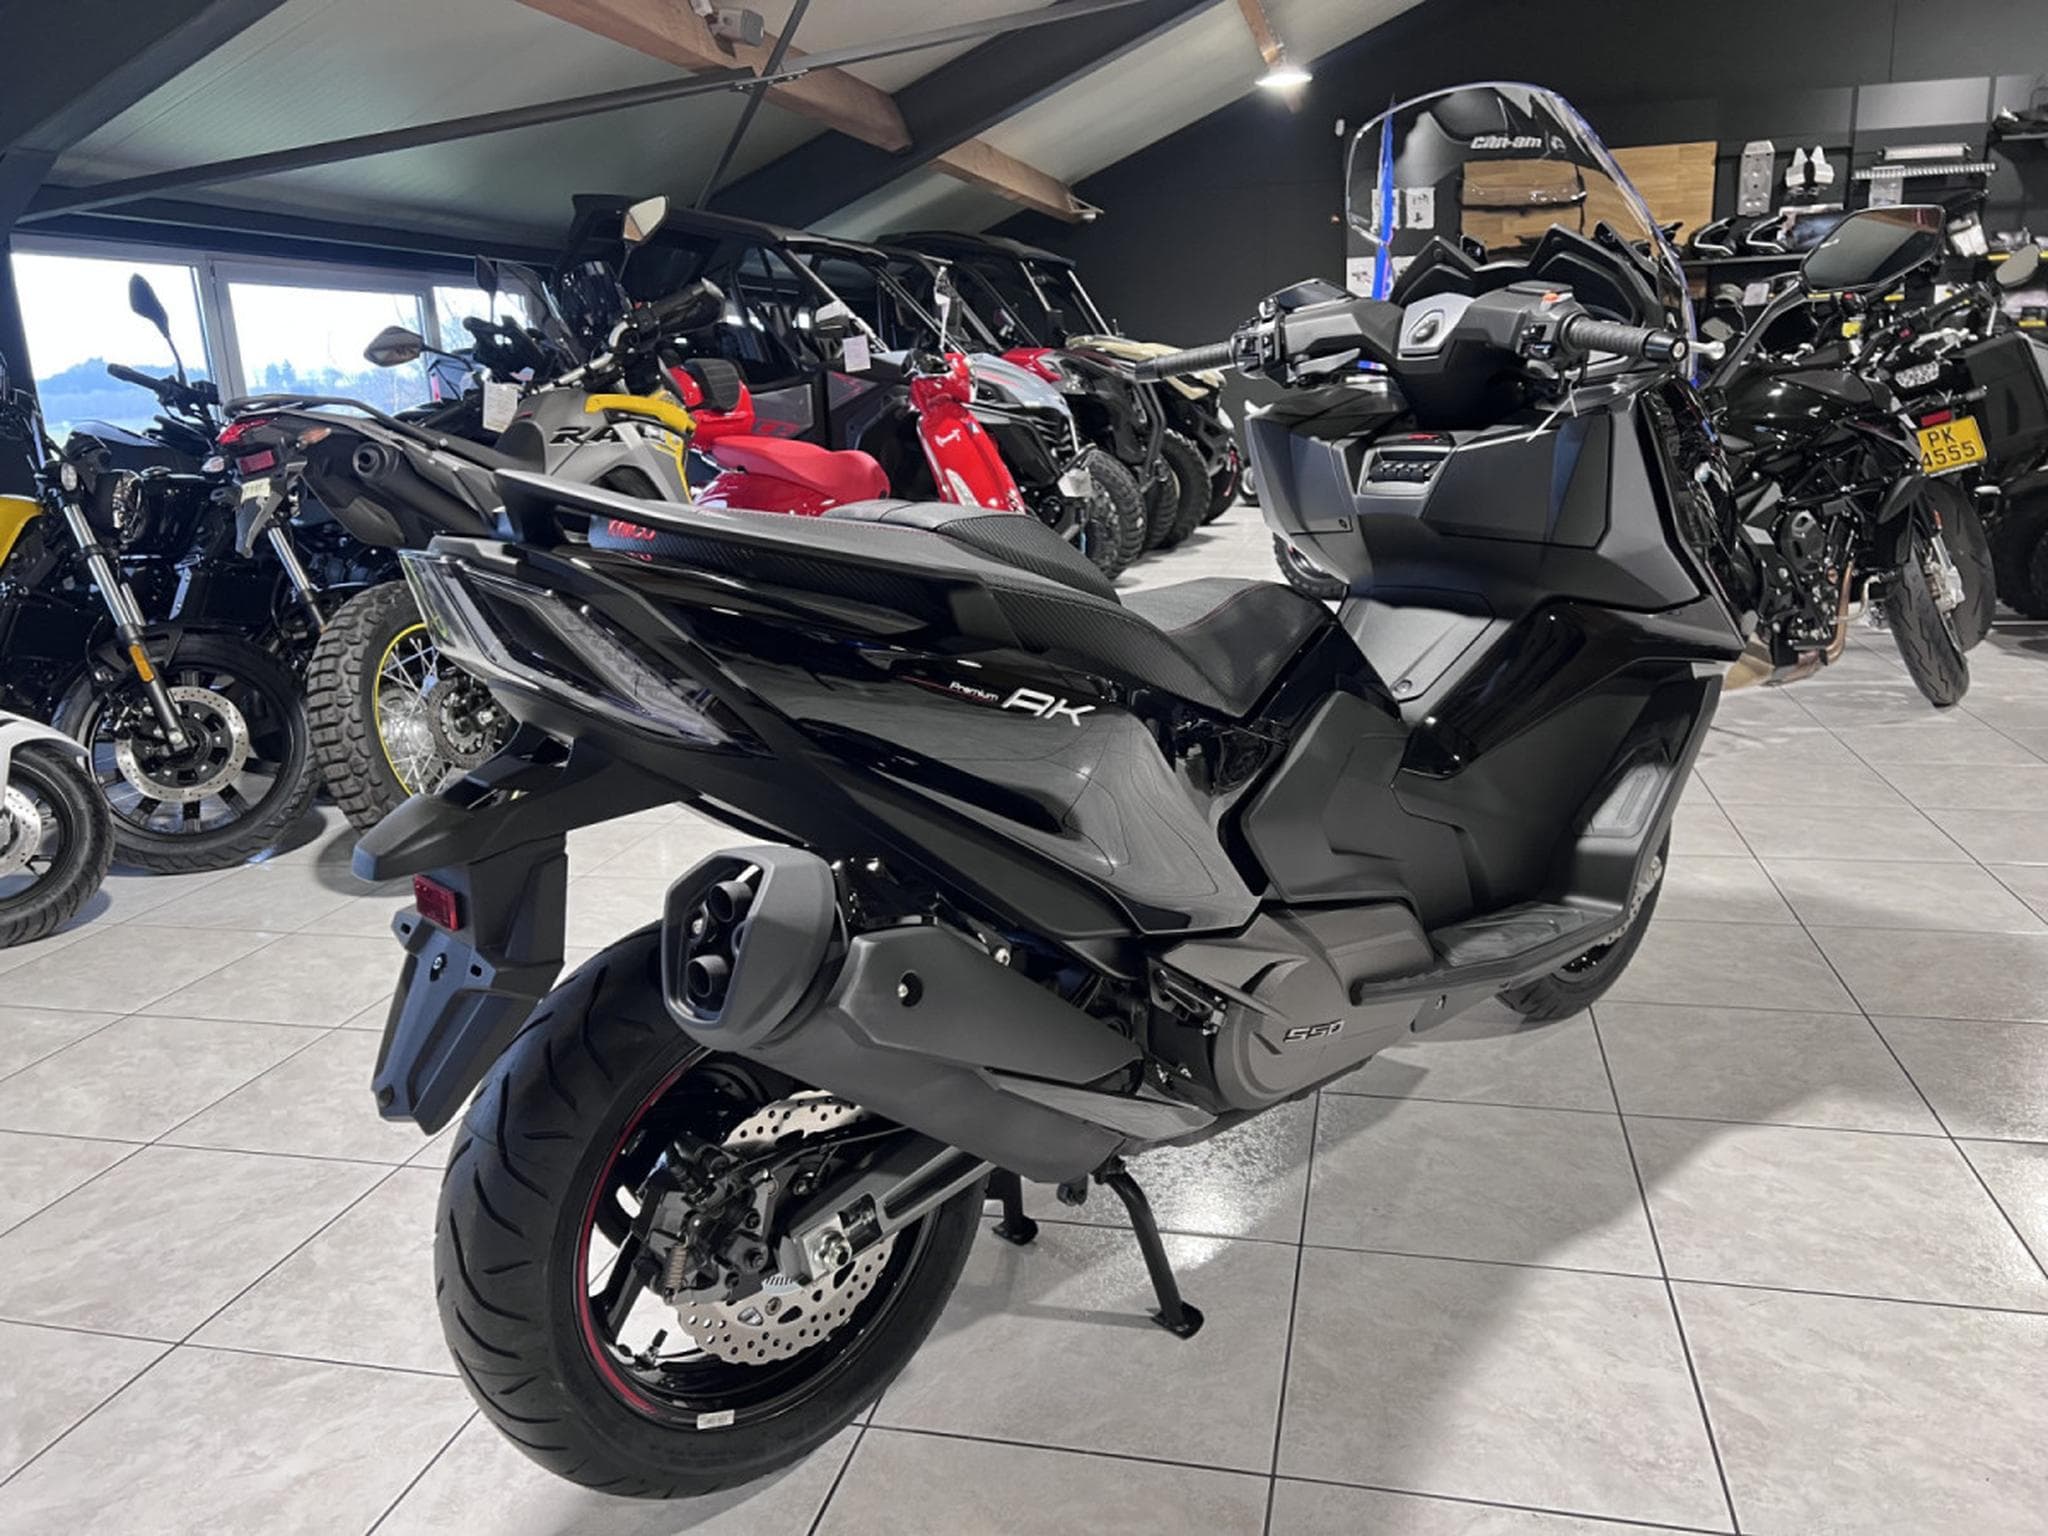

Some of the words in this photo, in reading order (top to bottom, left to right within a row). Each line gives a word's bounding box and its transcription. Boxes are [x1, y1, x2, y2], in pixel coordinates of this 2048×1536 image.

[1926, 426, 1956, 448] PK
[950, 681, 999, 701] Premium
[1001, 687, 1096, 726] AK
